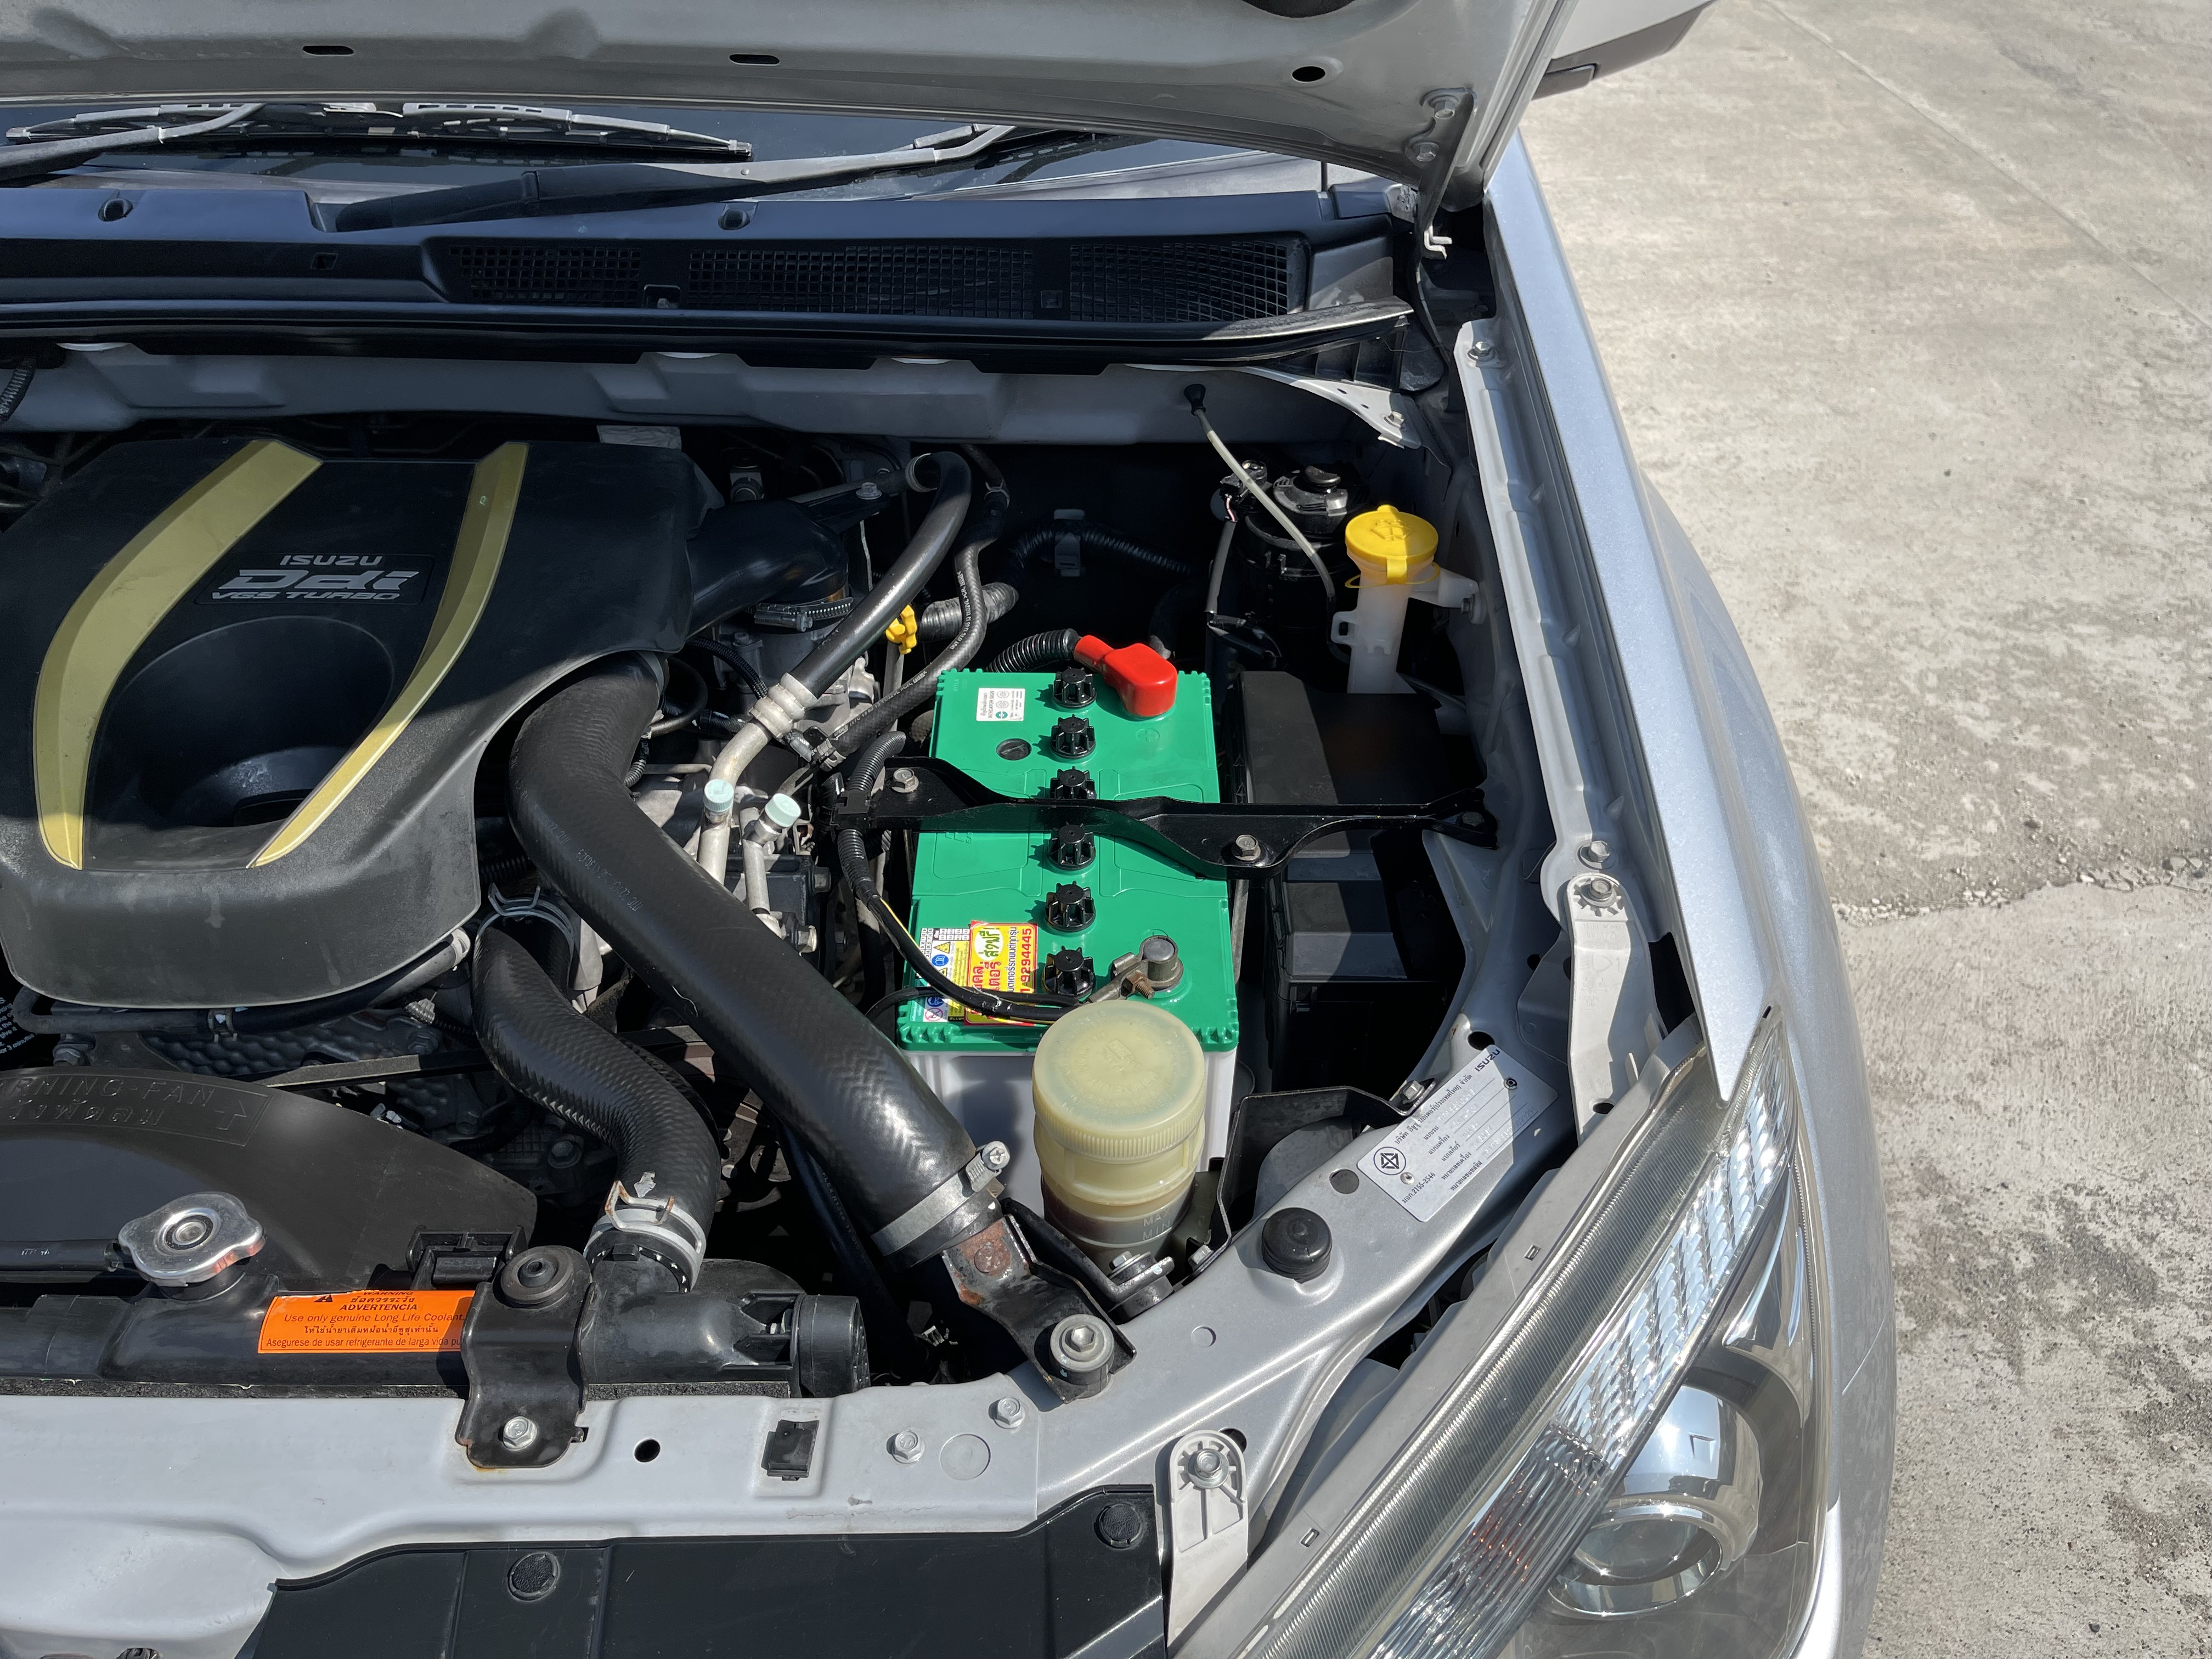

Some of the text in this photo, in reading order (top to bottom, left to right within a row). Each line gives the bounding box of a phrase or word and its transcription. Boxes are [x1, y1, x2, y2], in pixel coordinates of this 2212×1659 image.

[280, 555, 383, 566] ISUZU
[212, 591, 400, 600] VGS TURBO
[1474, 1048, 1501, 1072] ISUZU
[0, 1076, 216, 1107] RNING-FAN
[1402, 1171, 1436, 1204] มอก.2155-2546
[1144, 1209, 1171, 1227] MAX
[1143, 1220, 1170, 1240] MIN
[284, 1314, 304, 1322] Use
[307, 1314, 328, 1323] only
[330, 1314, 371, 1323] genuine
[374, 1314, 399, 1323] Long
[424, 1313, 466, 1322] Coolant.
[267, 1338, 309, 1348] Asegurese
[312, 1338, 323, 1346] de
[346, 1338, 394, 1348] refrigerante
[396, 1338, 406, 1346] de
[409, 1338, 430, 1347] larga
[432, 1338, 450, 1346] vida
